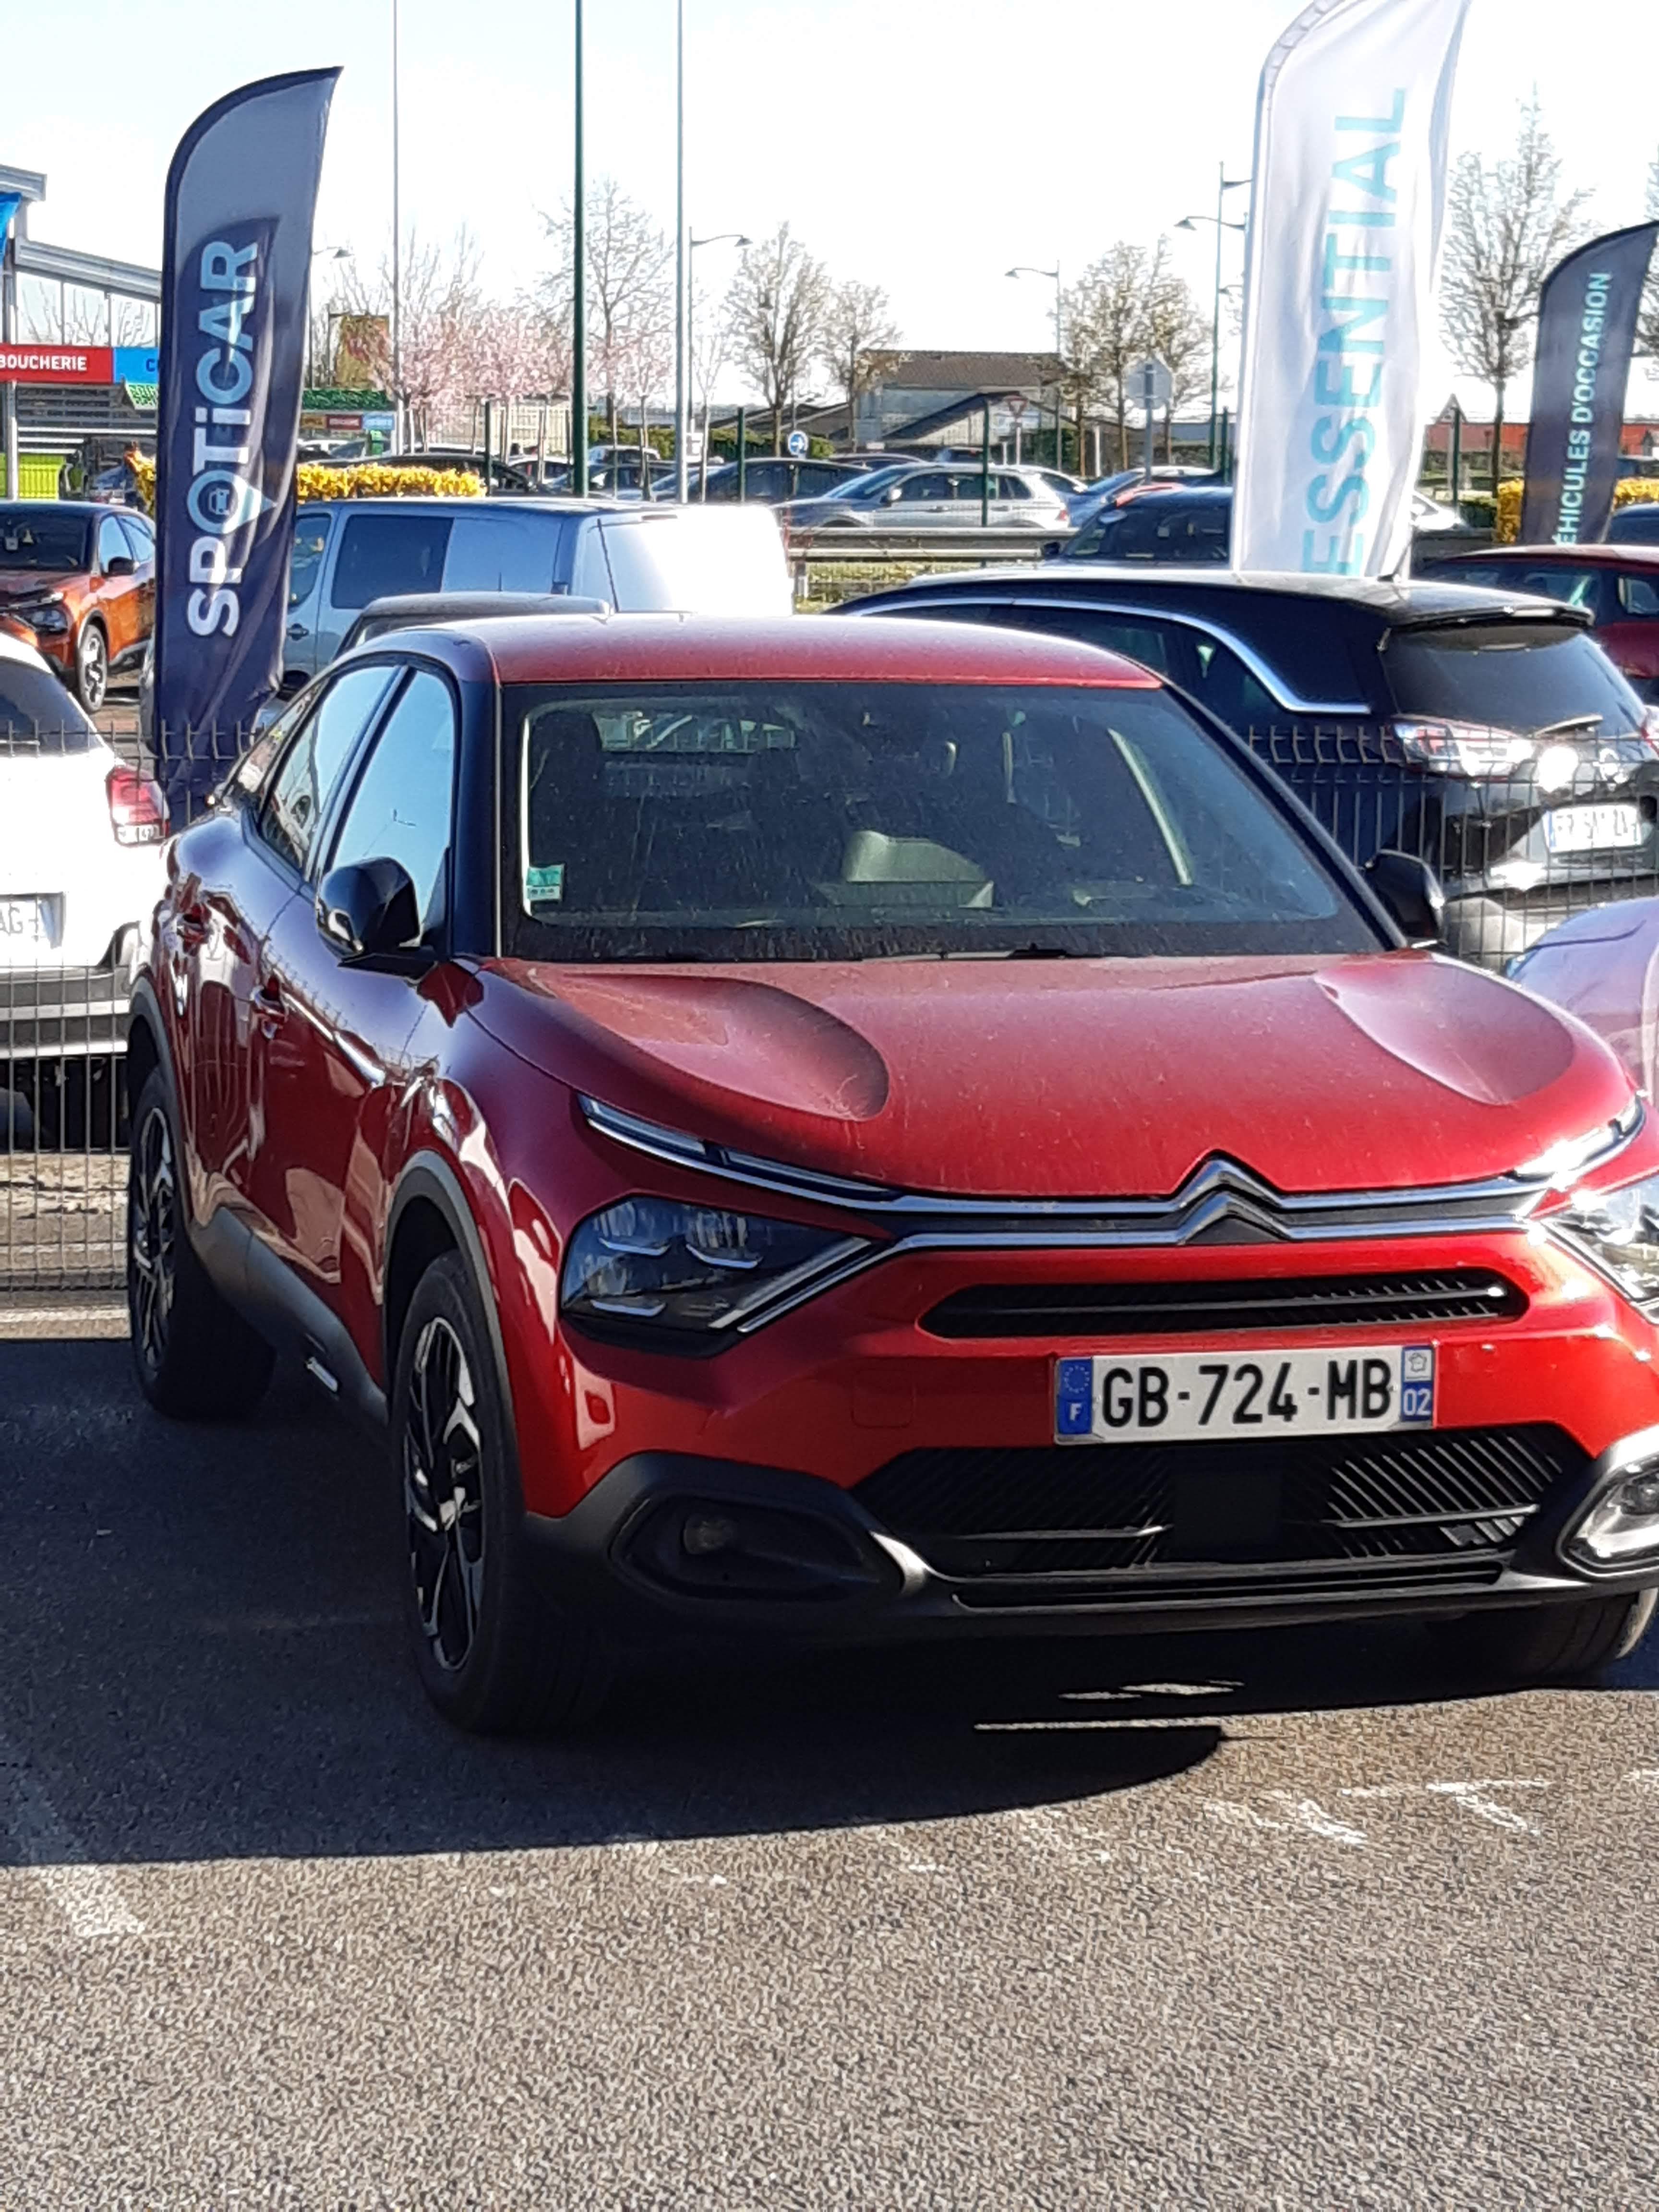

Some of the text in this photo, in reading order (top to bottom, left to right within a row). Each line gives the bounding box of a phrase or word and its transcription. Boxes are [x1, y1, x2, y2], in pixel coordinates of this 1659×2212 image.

[1301, 88, 1406, 576] ESSENTIAL
[0, 354, 87, 371] BOUCHERIE
[1551, 272, 1612, 547] ÉHICULES D'OCCASION
[1070, 1402, 1082, 1421] F
[1102, 1358, 1391, 1428] GB-724-MB
[1403, 1388, 1432, 1416] 02
